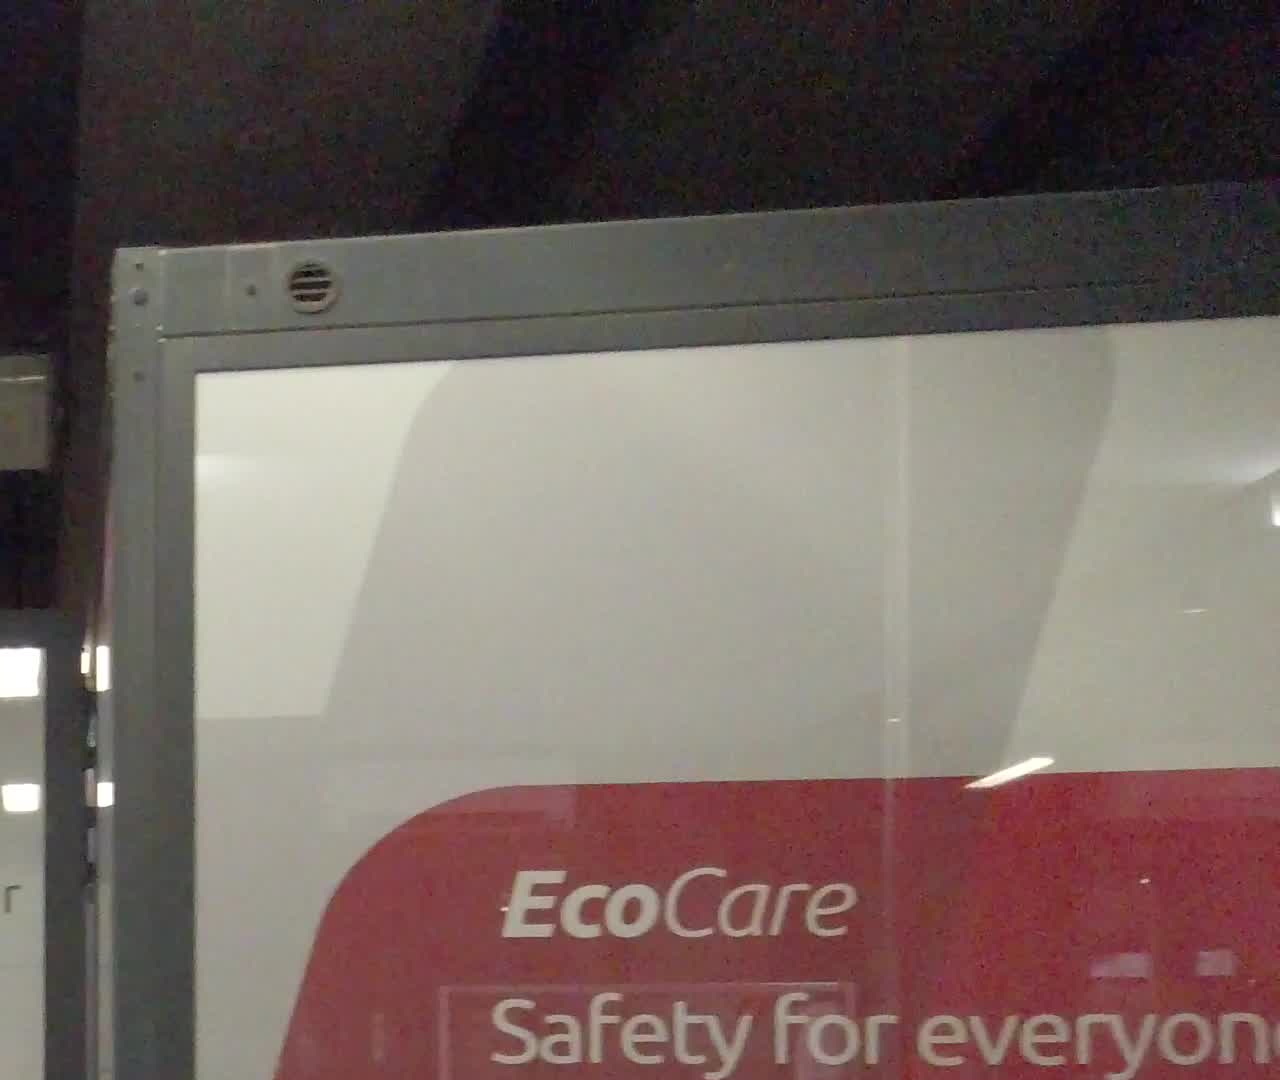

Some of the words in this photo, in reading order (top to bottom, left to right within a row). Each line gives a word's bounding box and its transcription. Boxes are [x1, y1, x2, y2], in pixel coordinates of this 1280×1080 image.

[500, 867, 859, 939] EcoCare
[490, 992, 753, 1080] Safety
[773, 992, 899, 1065] for
